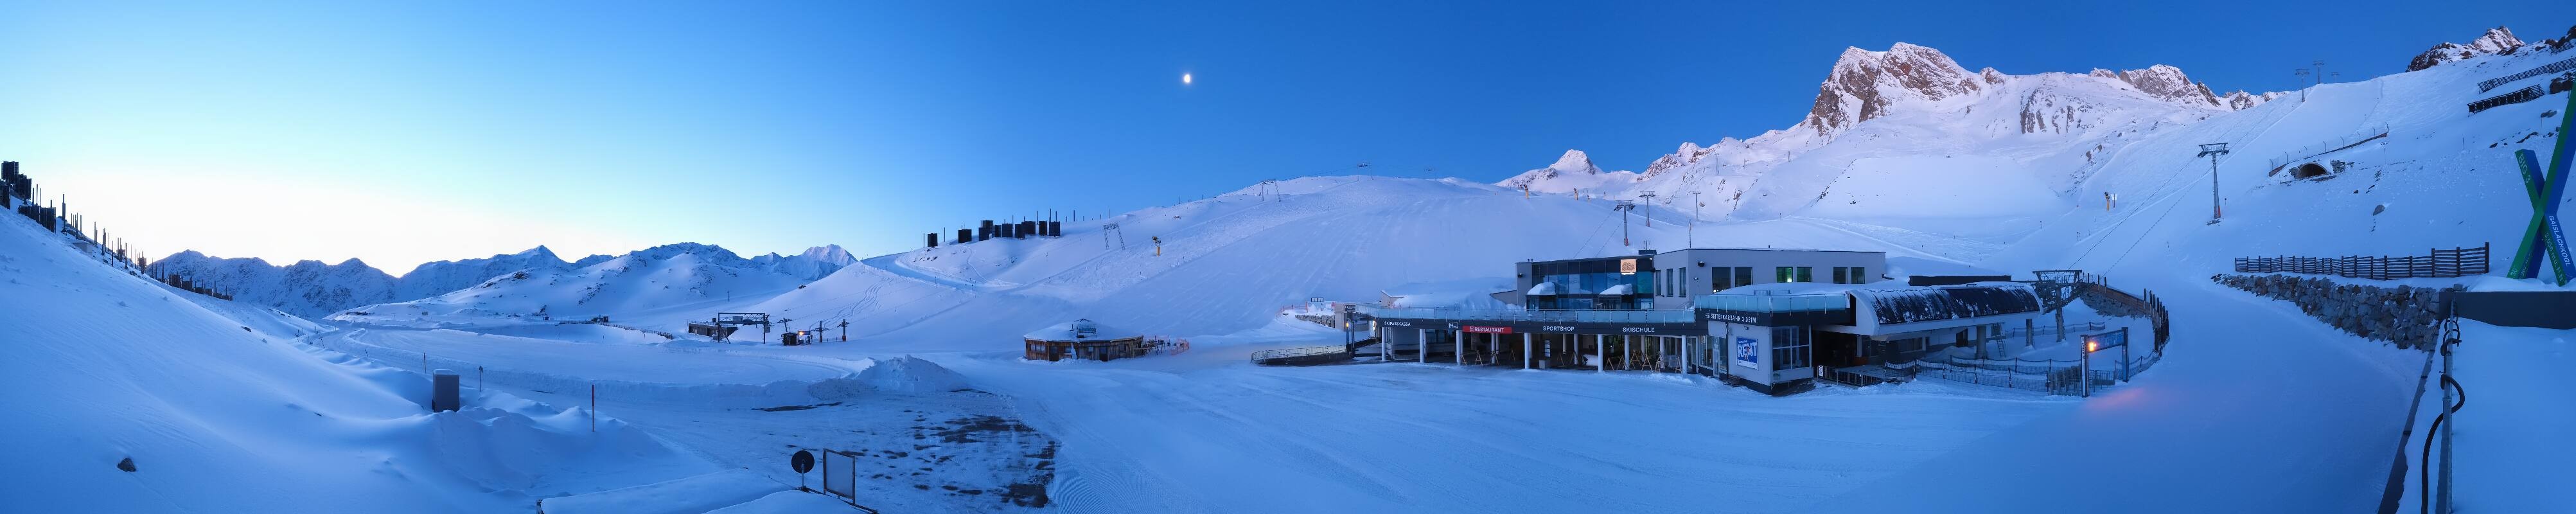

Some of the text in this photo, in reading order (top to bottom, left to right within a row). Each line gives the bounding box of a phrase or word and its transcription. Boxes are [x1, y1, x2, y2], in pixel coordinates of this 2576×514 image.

[2518, 154, 2531, 184] BIG 3
[2548, 215, 2571, 267] GAISLACHKOGL
